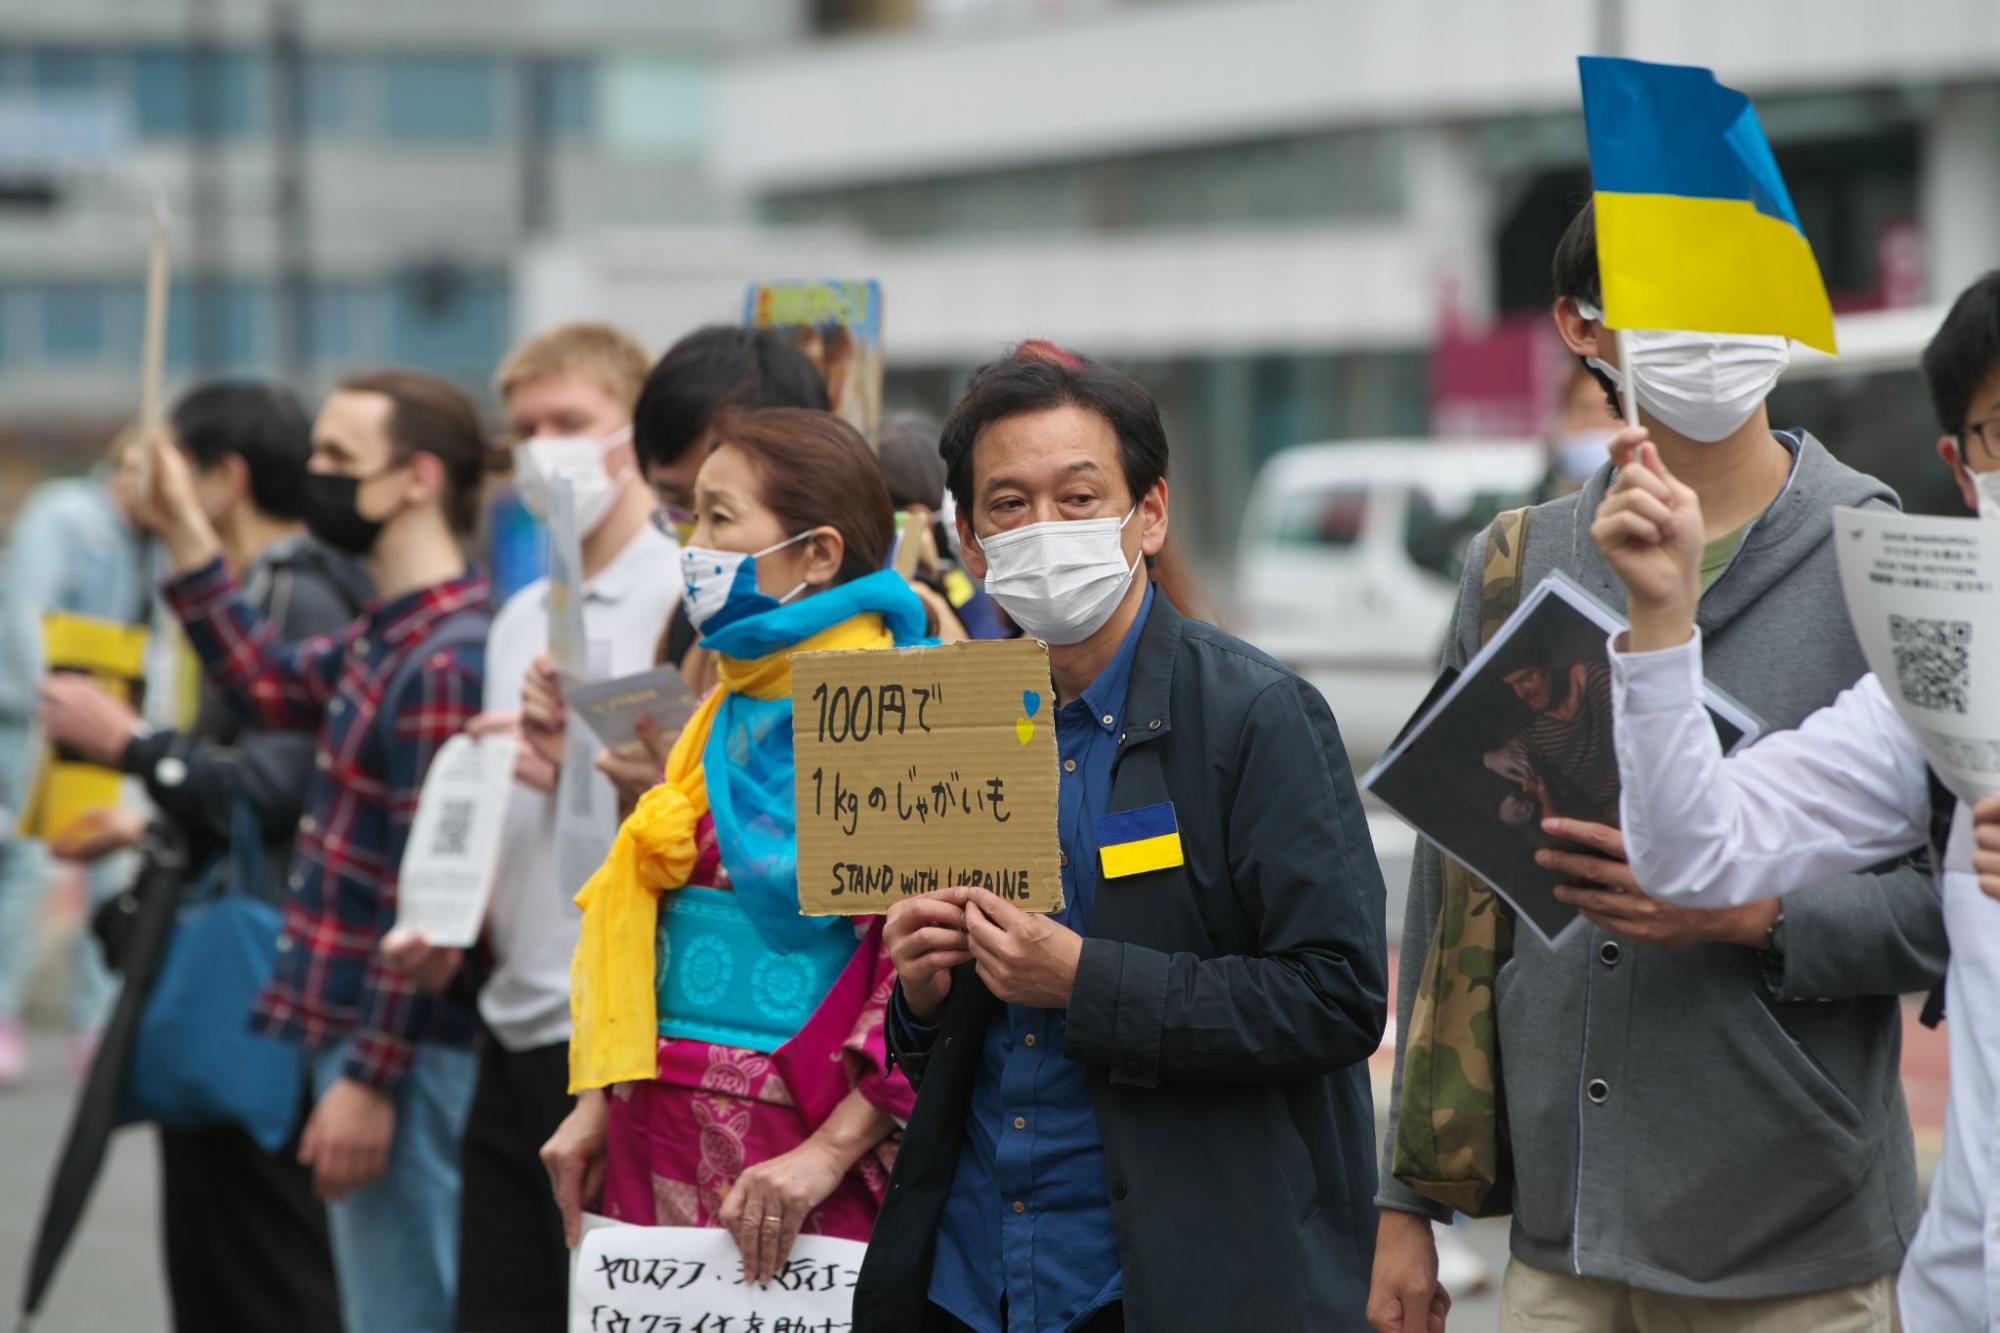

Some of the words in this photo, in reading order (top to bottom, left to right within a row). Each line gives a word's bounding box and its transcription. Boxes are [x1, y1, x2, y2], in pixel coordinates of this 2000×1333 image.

[812, 681, 943, 743] 100円で
[831, 862, 894, 896] STAND
[901, 867, 938, 895] WITH
